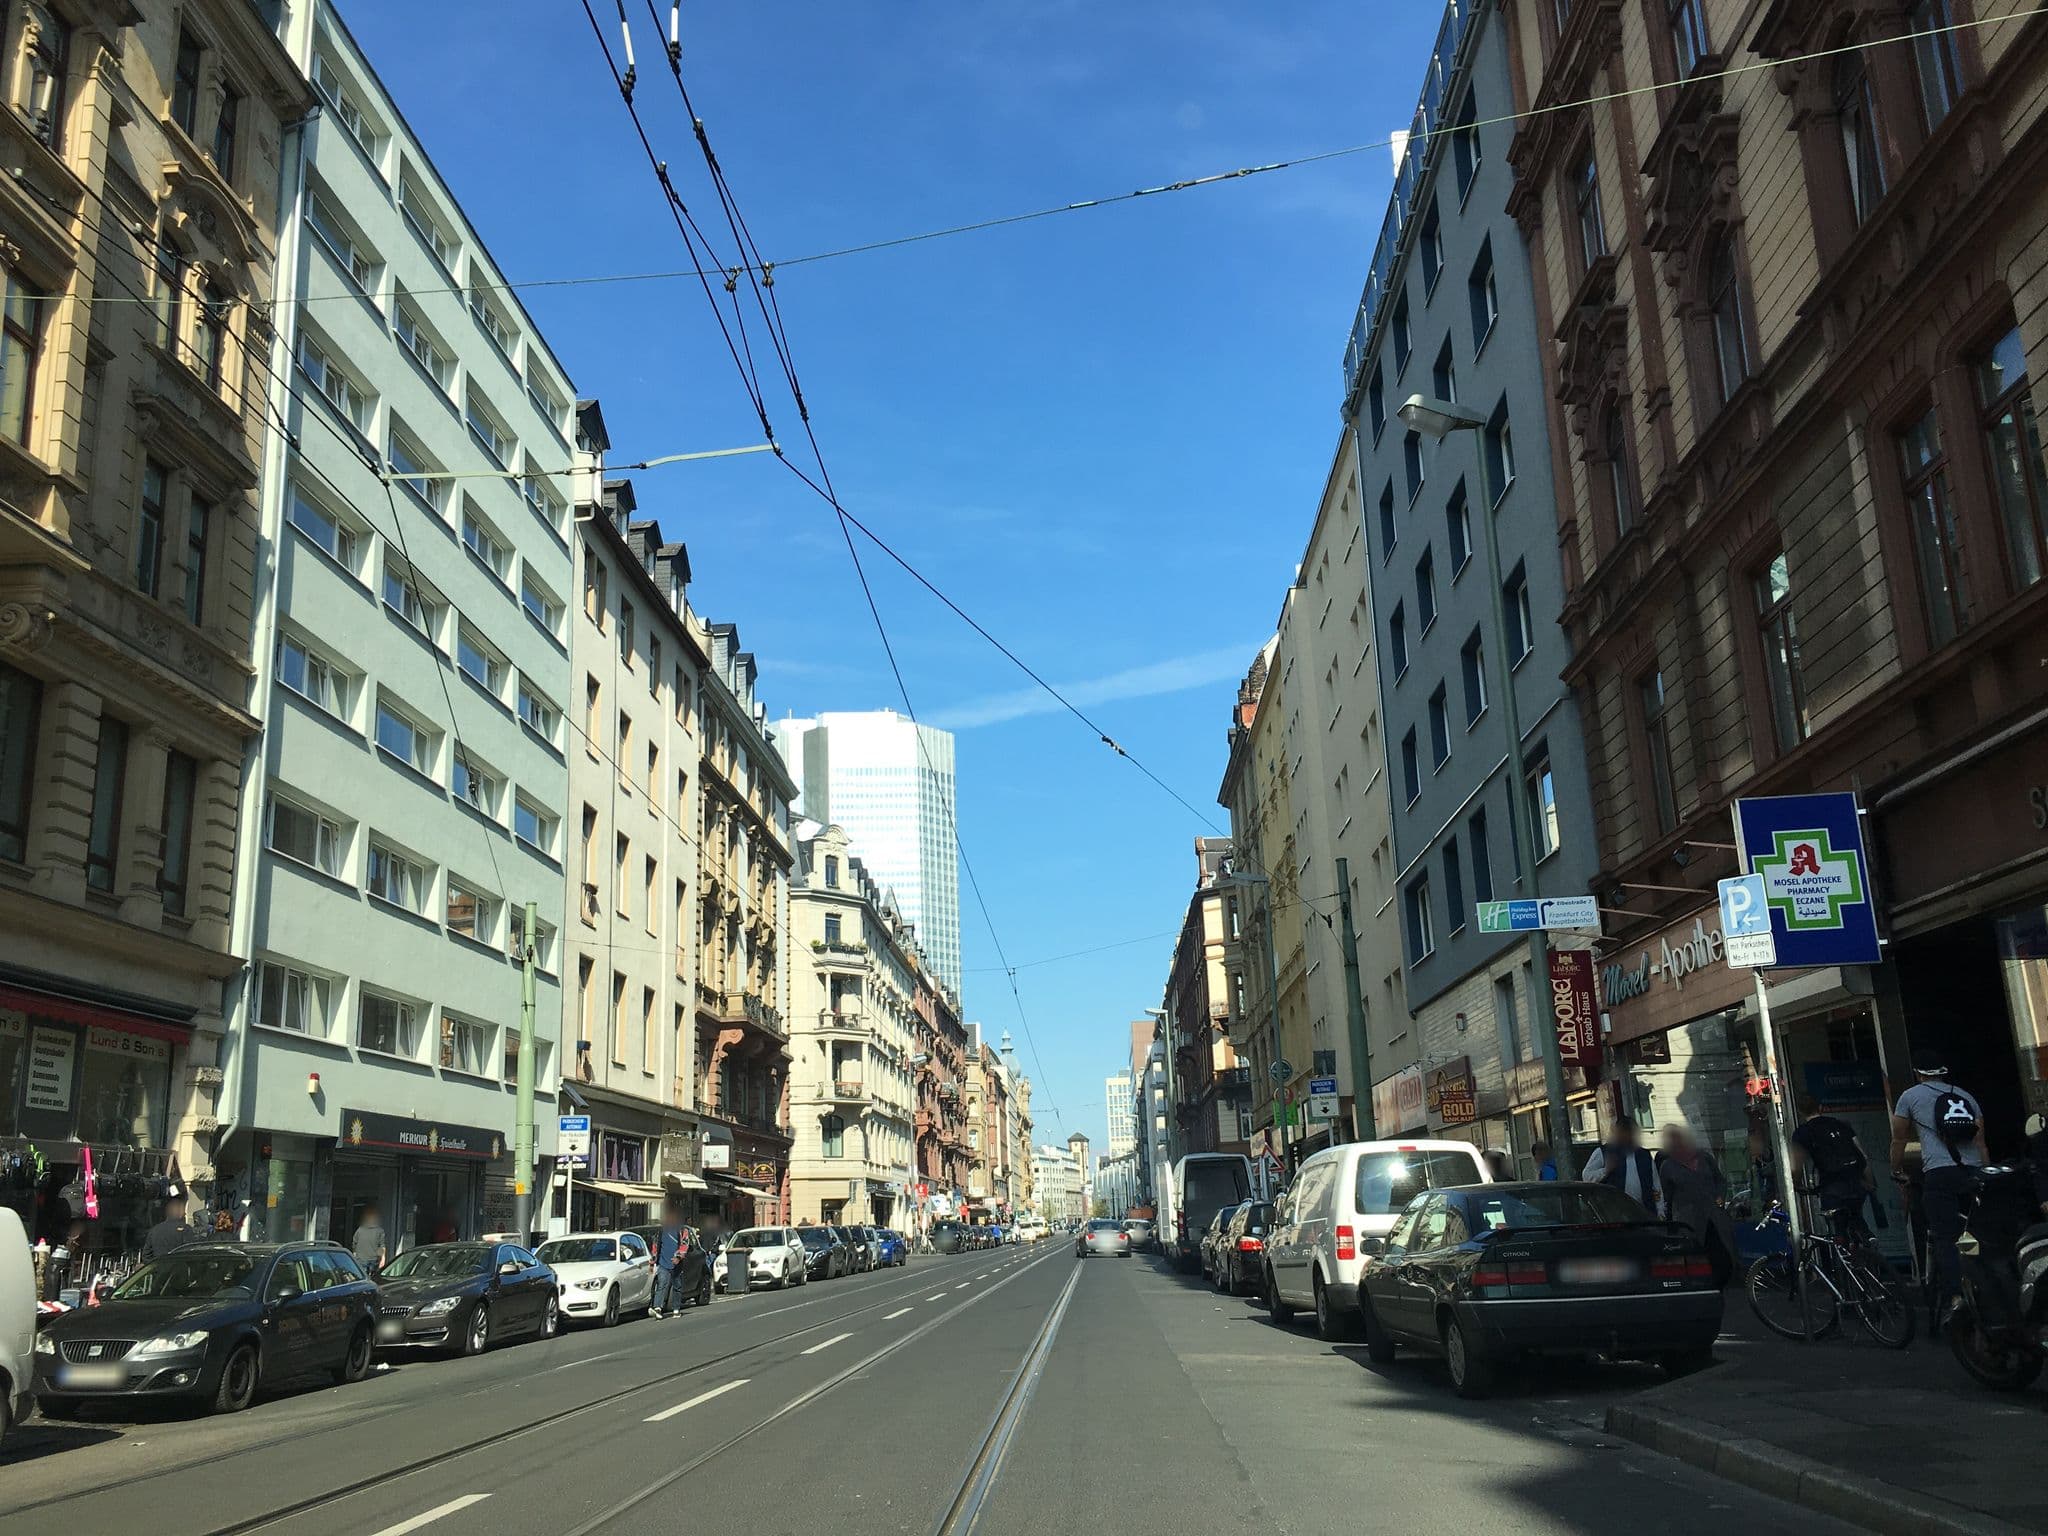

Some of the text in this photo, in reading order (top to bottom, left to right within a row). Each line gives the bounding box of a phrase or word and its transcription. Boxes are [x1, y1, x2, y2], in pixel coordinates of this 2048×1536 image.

[1774, 876, 1842, 887] MOSEL APOTHEKE
[1787, 886, 1830, 895] PHARMACY
[1726, 885, 1752, 929] P
[1796, 896, 1825, 905] ECZANE
[1548, 917, 1594, 925] Hauptbahnhof
[1549, 910, 1594, 919] Frankfurt City
[1603, 918, 1723, 1006] Mosel-Apothe
[1581, 991, 1595, 1047] Kebab Haus
[90, 1031, 118, 1048] Lund
[121, 1038, 130, 1050] &
[1442, 1103, 1475, 1117] GOLD
[399, 1131, 428, 1146] MERKUR
